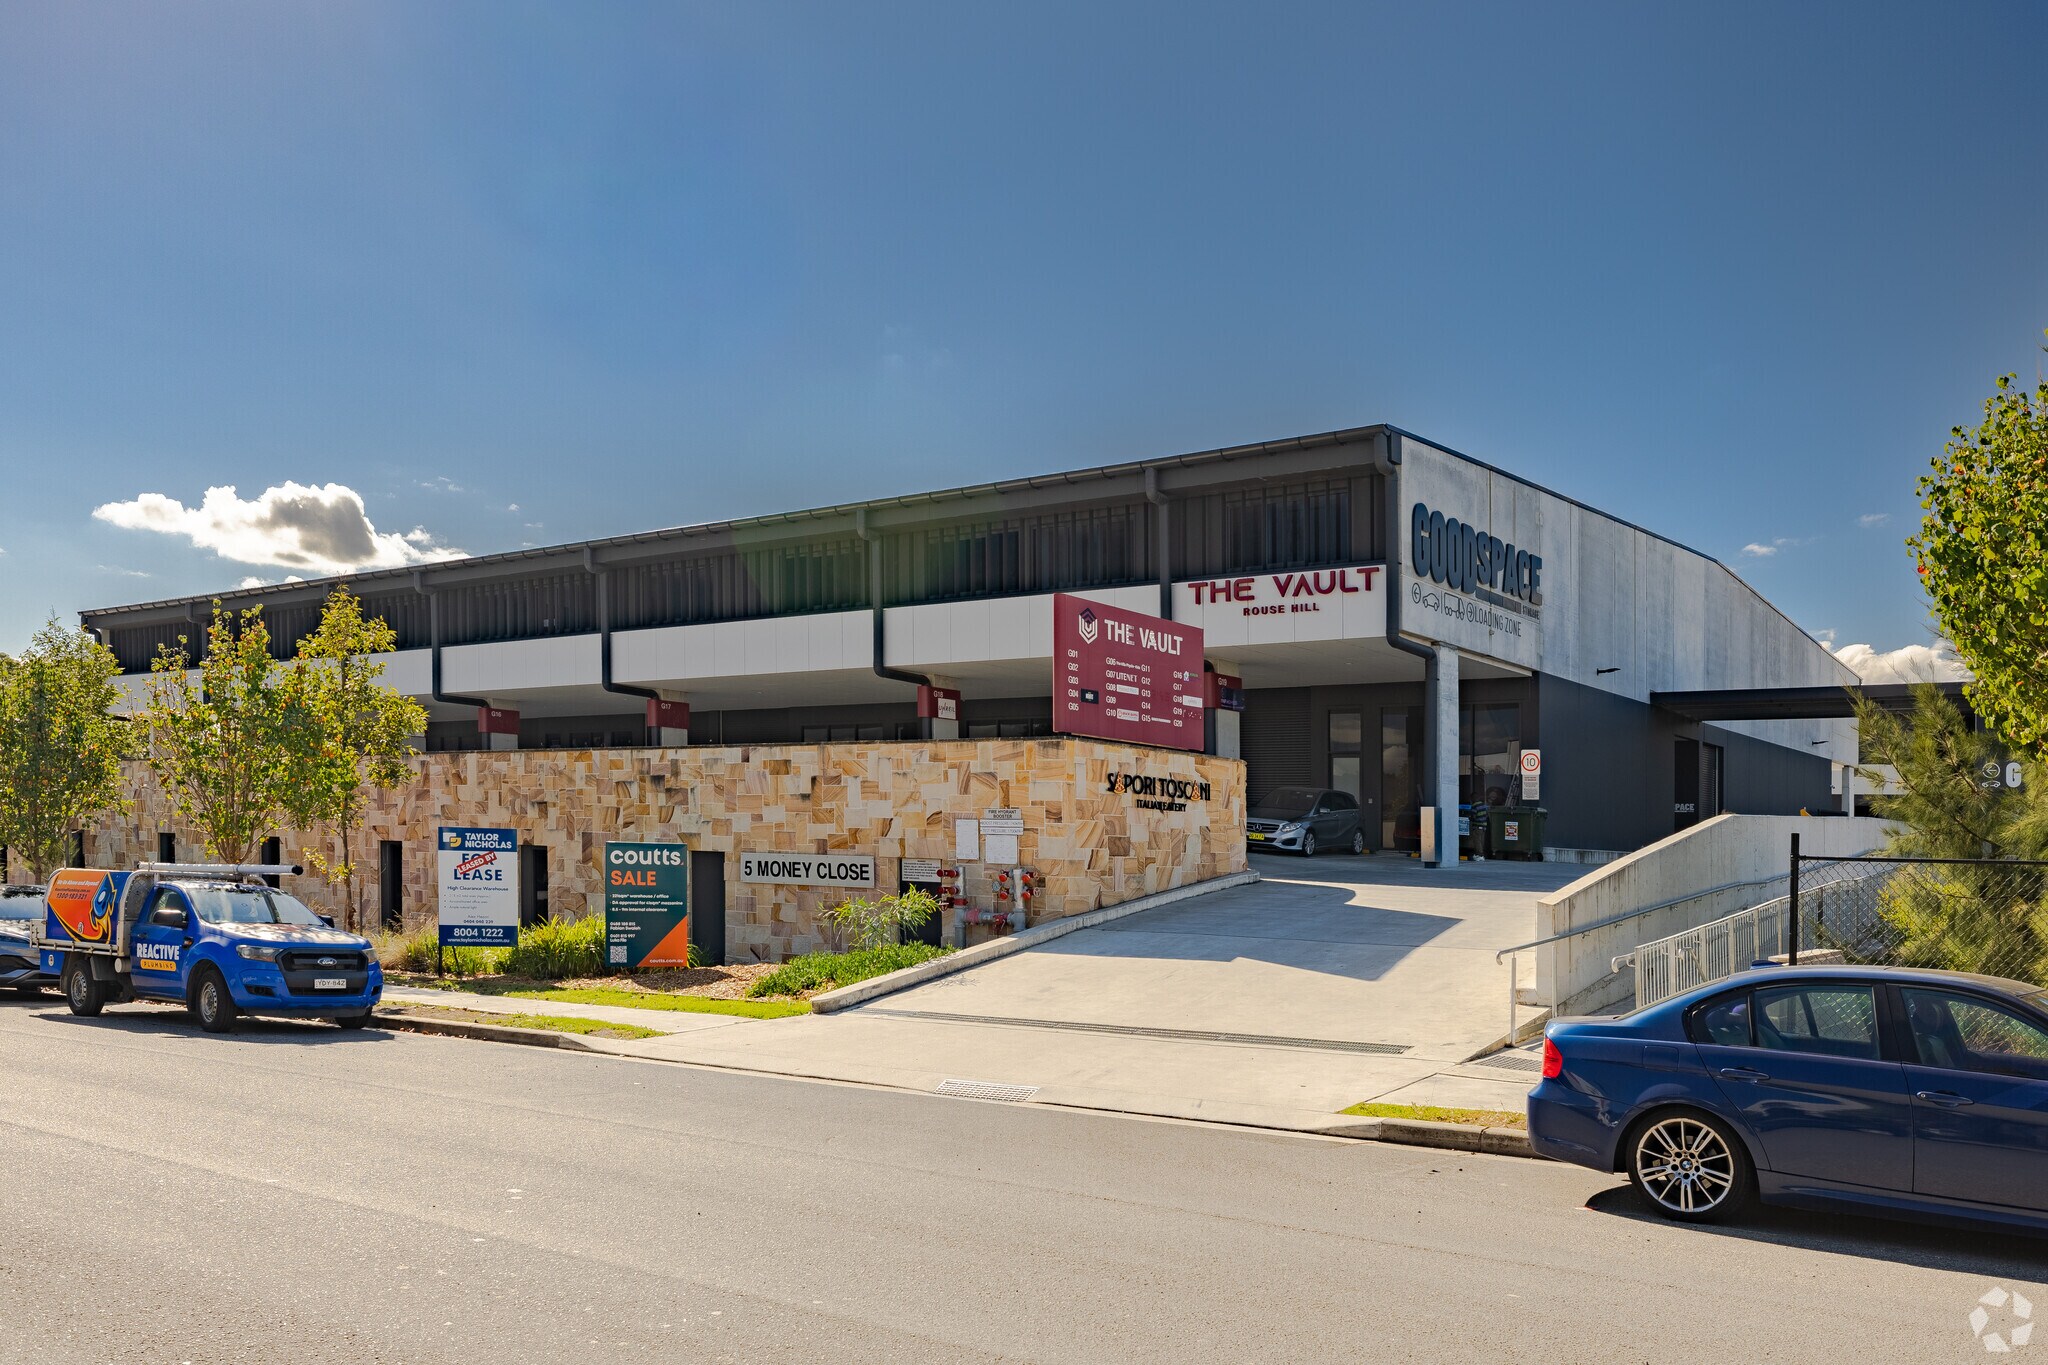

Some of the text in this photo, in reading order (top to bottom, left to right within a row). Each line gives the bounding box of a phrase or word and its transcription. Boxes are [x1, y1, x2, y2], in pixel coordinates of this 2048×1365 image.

[1411, 502, 1542, 607] GOODSPACE
[1188, 567, 1380, 605] THE VAULT
[1243, 602, 1320, 616] ROUSE HILL
[1474, 606, 1522, 638] LOADING ZONE
[1104, 618, 1183, 656] THE VAULT
[1068, 649, 1078, 658] G01
[1068, 662, 1078, 672] G02
[1141, 664, 1150, 673] G11
[1106, 670, 1116, 678] G07
[1068, 676, 1078, 684] G03
[1142, 676, 1151, 686] G12
[1142, 702, 1151, 710] G14
[1106, 708, 1116, 717] G10
[1526, 758, 1536, 767] 10
[2006, 762, 2022, 788] G
[465, 832, 500, 841] TAYLOR
[465, 840, 512, 850] NICHOLAS
[457, 858, 484, 872] LEASED
[484, 852, 496, 862] BY
[610, 848, 681, 866] coutts
[454, 868, 502, 881] LEASE
[744, 860, 870, 881] 5 MONEY CLOSE
[611, 870, 656, 886] SALE
[454, 928, 504, 938] 8004 1222
[136, 943, 180, 960] REACTIVE
[144, 961, 173, 969] PLUMBING
